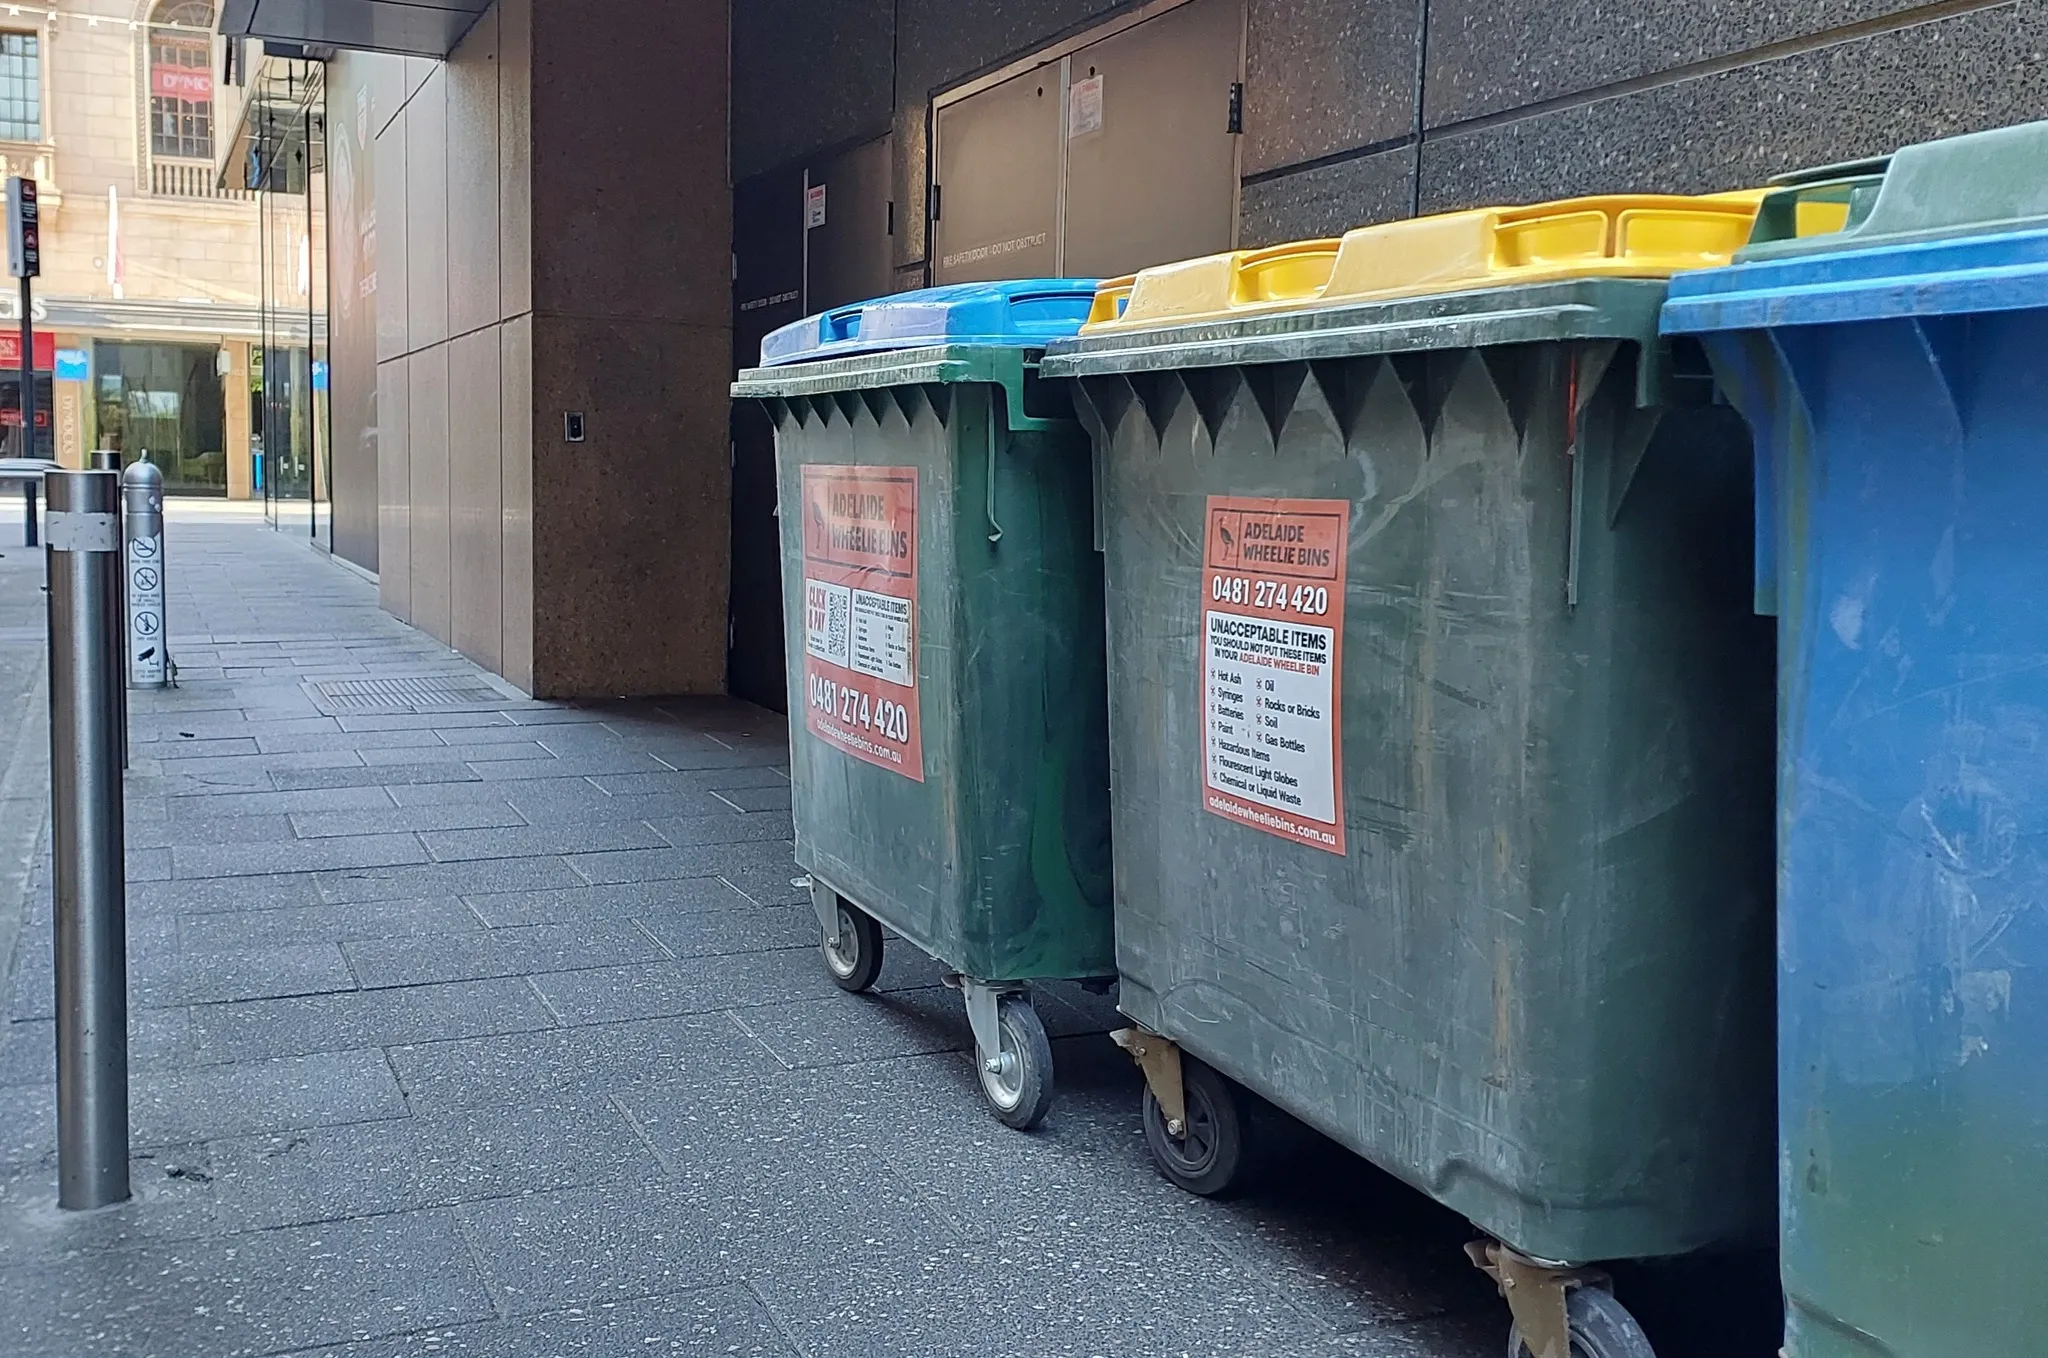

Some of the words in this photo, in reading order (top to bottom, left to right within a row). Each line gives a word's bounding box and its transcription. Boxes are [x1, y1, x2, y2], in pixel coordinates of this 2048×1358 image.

[992, 243, 1001, 255] DO
[1002, 240, 1015, 252] NOT
[1016, 233, 1046, 249] OBSTRUCT
[833, 492, 884, 521] ADELAIDE
[832, 524, 876, 553] WHEELIE
[879, 529, 907, 558] BINS
[1244, 522, 1304, 542] ADELAIDE
[1244, 543, 1296, 564] WHEELIE
[1298, 548, 1330, 567] BINS
[1212, 575, 1250, 605] 0481
[1254, 580, 1288, 610] 274
[1291, 585, 1328, 614] 420
[890, 601, 907, 615] ITEMS
[1210, 618, 1288, 644] UNACCEPTABLE
[1291, 630, 1326, 650] ITEMS
[1210, 635, 1222, 646] YOU
[1223, 636, 1249, 651] SHOULD
[1250, 643, 1264, 654] NOT
[1264, 645, 1278, 656] PUT
[1280, 647, 1302, 660] THESE
[1302, 651, 1326, 664] ITEMS
[1214, 648, 1220, 657] IN
[1221, 649, 1238, 660] YOUR
[1240, 652, 1272, 668] ADELAIDE
[1273, 658, 1305, 674] WHEELIE
[1306, 664, 1320, 676] BIN
[1218, 669, 1228, 682] Hot
[1230, 672, 1242, 684] Ash
[1264, 680, 1274, 692] Oil
[1218, 687, 1243, 704] Syringes
[810, 673, 836, 717] 0481
[841, 686, 870, 730] 274
[874, 698, 908, 743] 420
[1218, 704, 1244, 720] Batteries
[1264, 698, 1286, 712] Rocks
[1287, 704, 1296, 714] or
[1296, 704, 1320, 719] Bricks
[1218, 722, 1234, 735] Paint
[1265, 716, 1278, 728] Soil
[816, 718, 902, 764] adelaidewheeliebins.com.au
[1218, 738, 1250, 756] Hazardous
[1252, 747, 1270, 762] Items
[1265, 734, 1278, 747] Gas
[1280, 736, 1305, 753] Bottles
[1255, 766, 1272, 781] Light
[1274, 771, 1298, 787] Globes
[1220, 772, 1246, 790] Chemical
[1248, 783, 1255, 792] or
[1256, 784, 1278, 800] Liquid
[1278, 790, 1302, 806] Waste
[1209, 796, 1336, 845] adelaidewheeliebins.com.au
